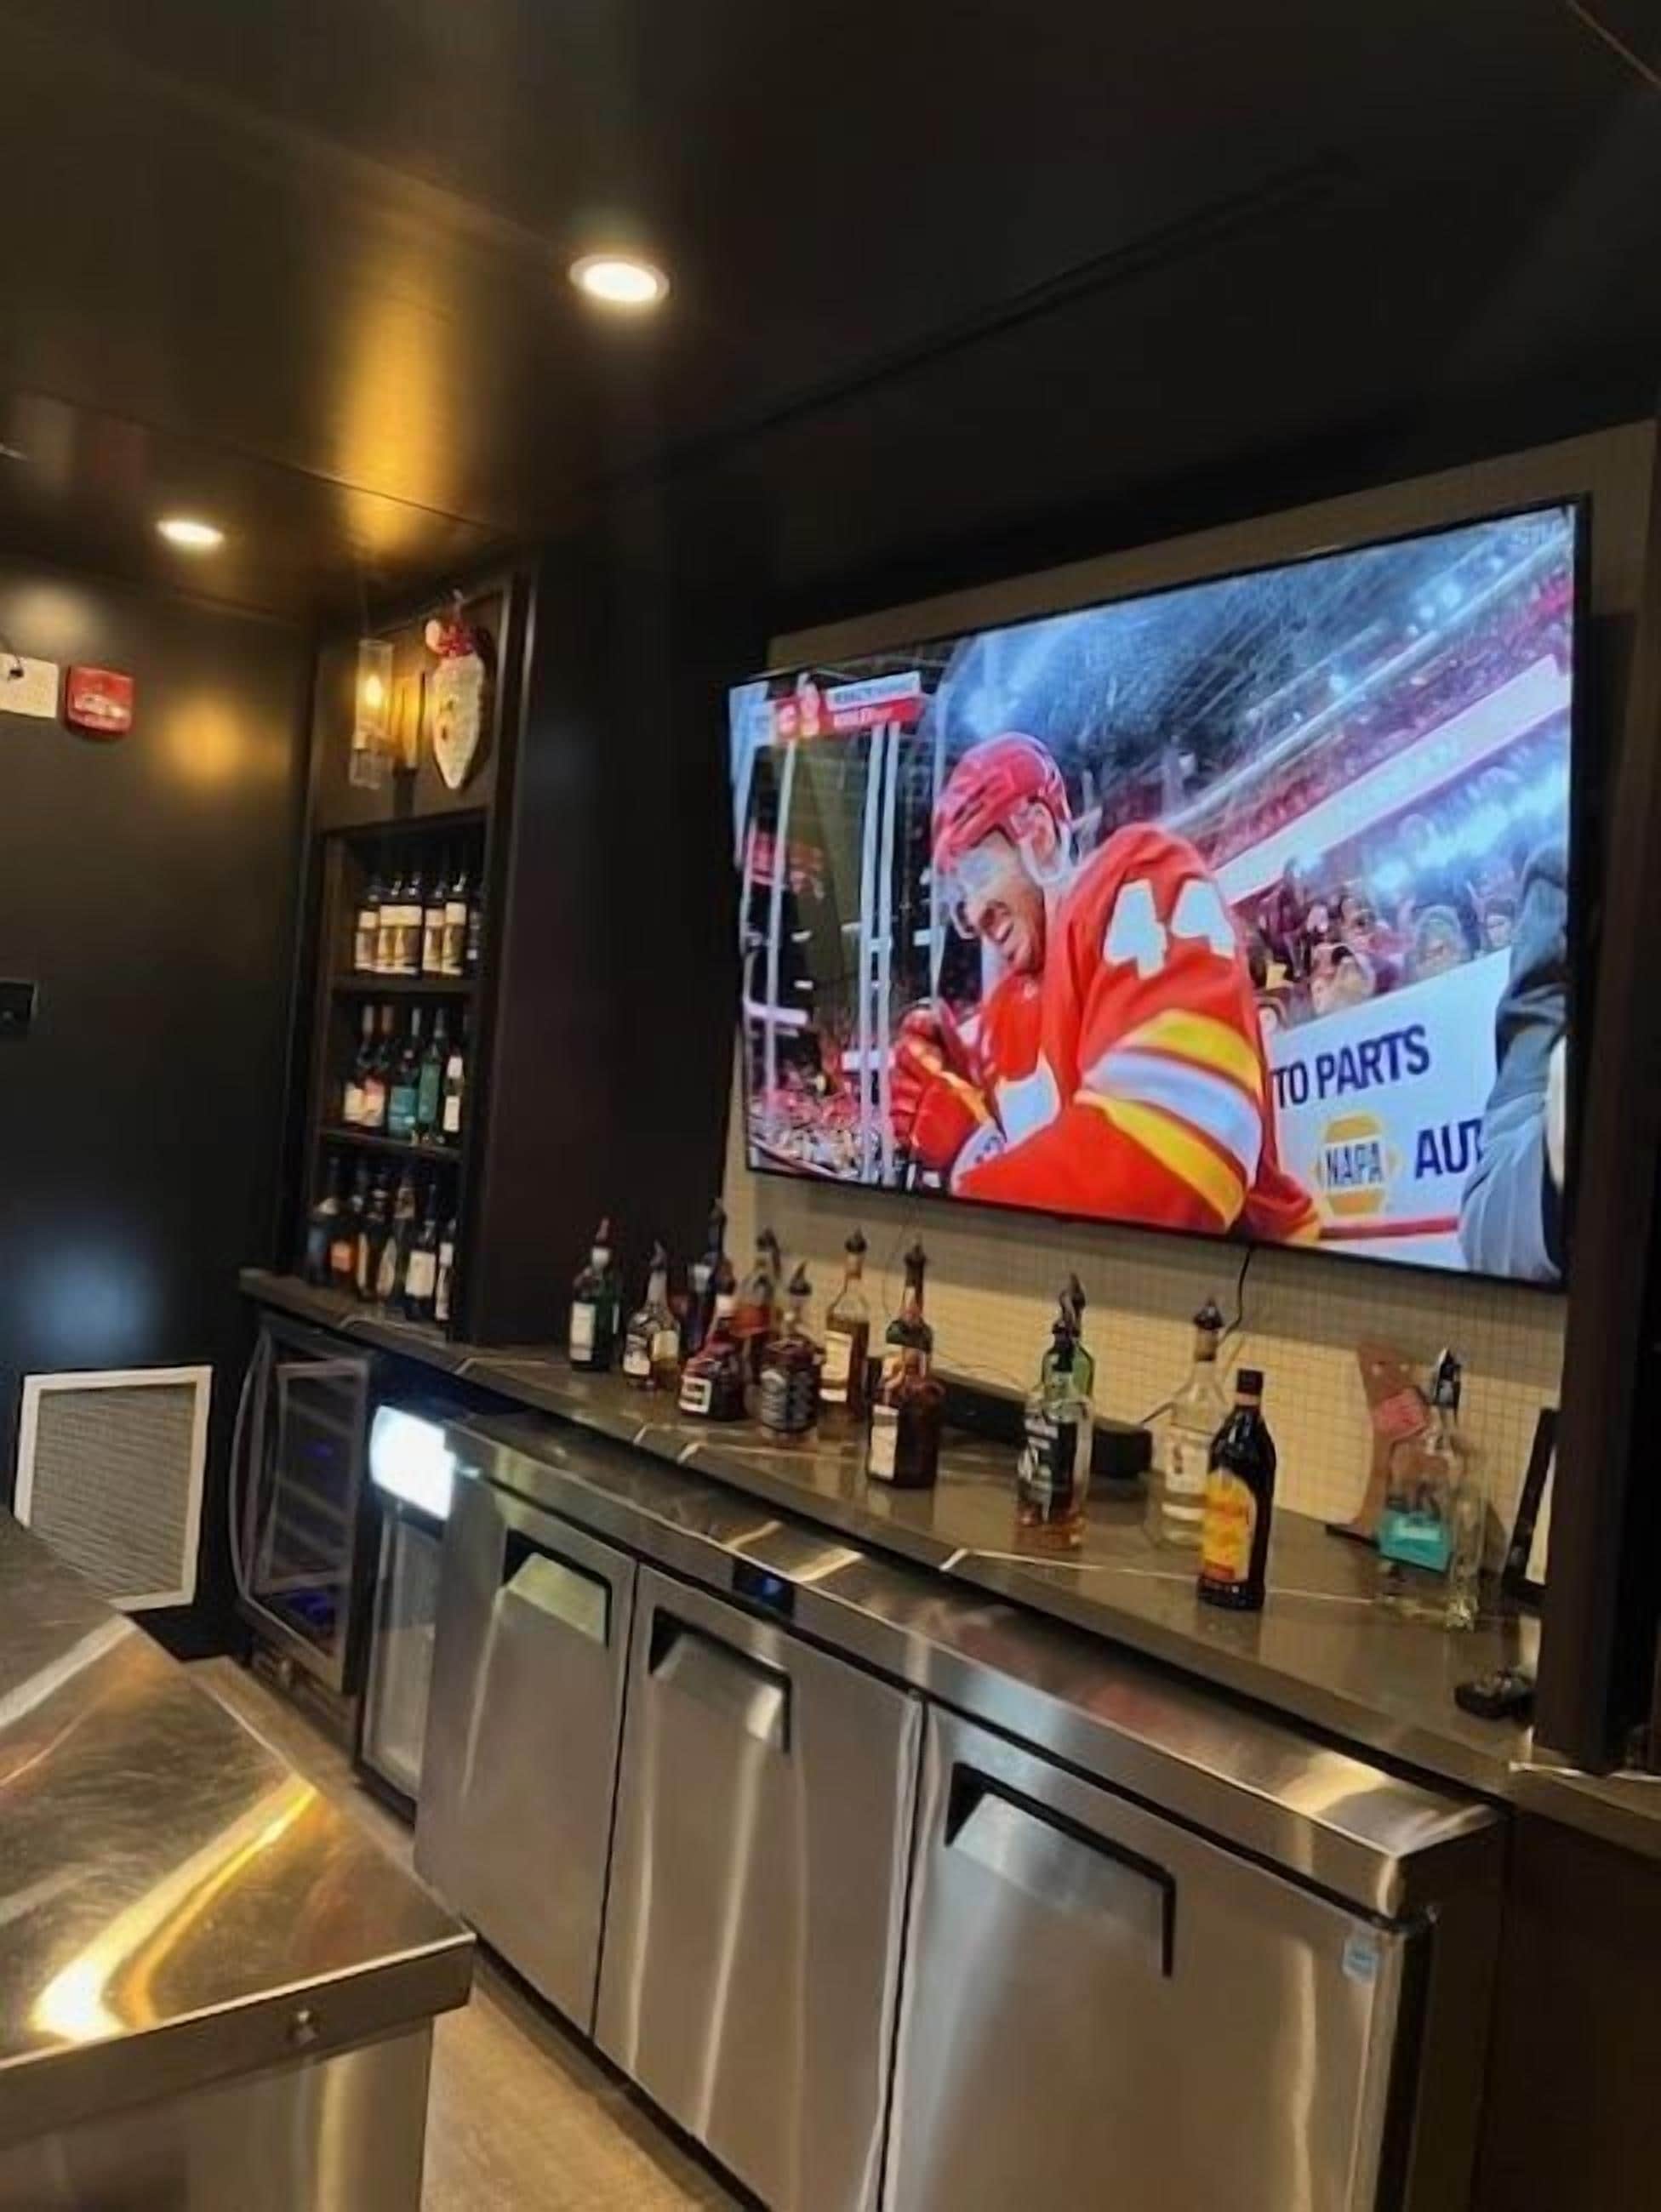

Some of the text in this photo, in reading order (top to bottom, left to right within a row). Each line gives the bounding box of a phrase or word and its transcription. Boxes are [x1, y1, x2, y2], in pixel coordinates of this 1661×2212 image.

[1104, 877, 1234, 980] 44
[1270, 1023, 1430, 1109] TO PARTS
[1325, 1141, 1383, 1188] NAPA
